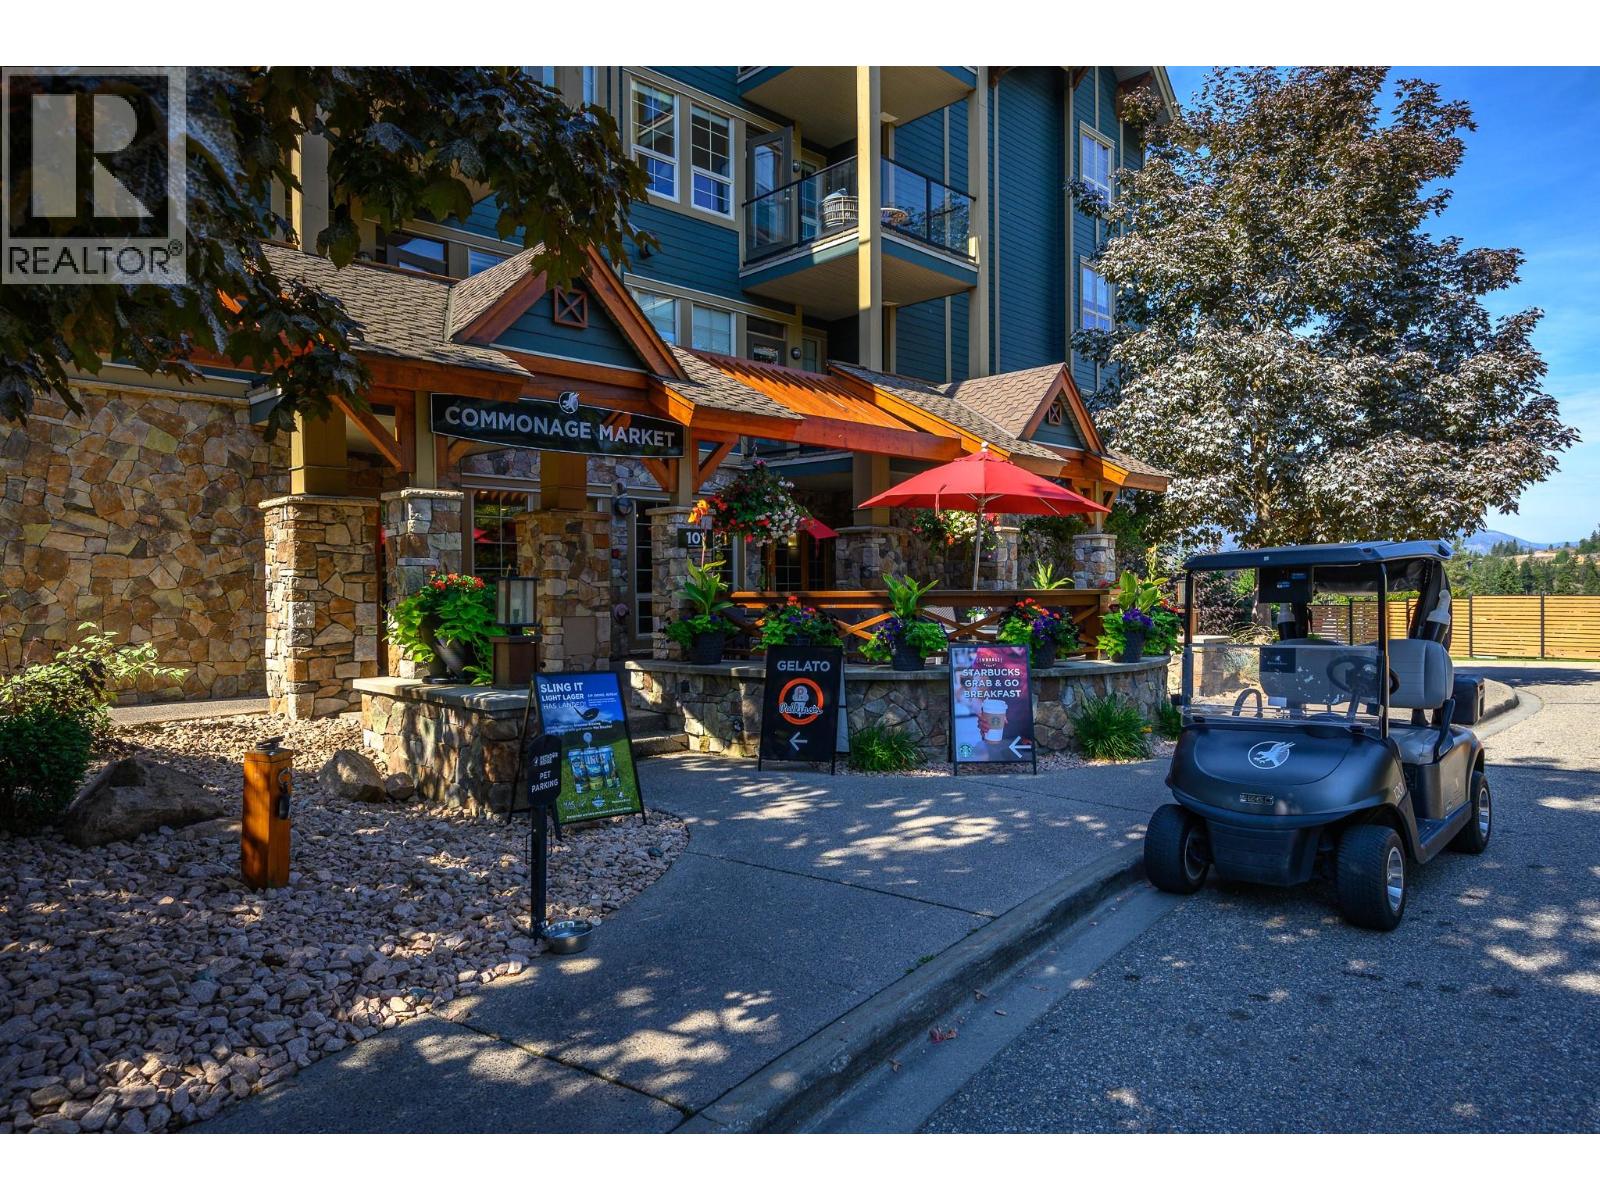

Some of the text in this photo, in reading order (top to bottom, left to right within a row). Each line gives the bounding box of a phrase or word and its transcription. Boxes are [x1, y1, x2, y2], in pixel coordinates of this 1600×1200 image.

[444, 406, 676, 448] COMMONAGE MARKET
[776, 660, 831, 672] GELATO
[962, 668, 1021, 677] STARBUCKS
[540, 682, 584, 693] SLING IT
[964, 679, 1020, 688] GRAB & GO
[541, 694, 562, 702] LIGHT
[562, 693, 585, 701] LAGER
[964, 690, 1022, 698] BREAKFAST
[543, 702, 557, 710] HAS
[539, 770, 552, 780] PET
[531, 778, 559, 793] PARKING
